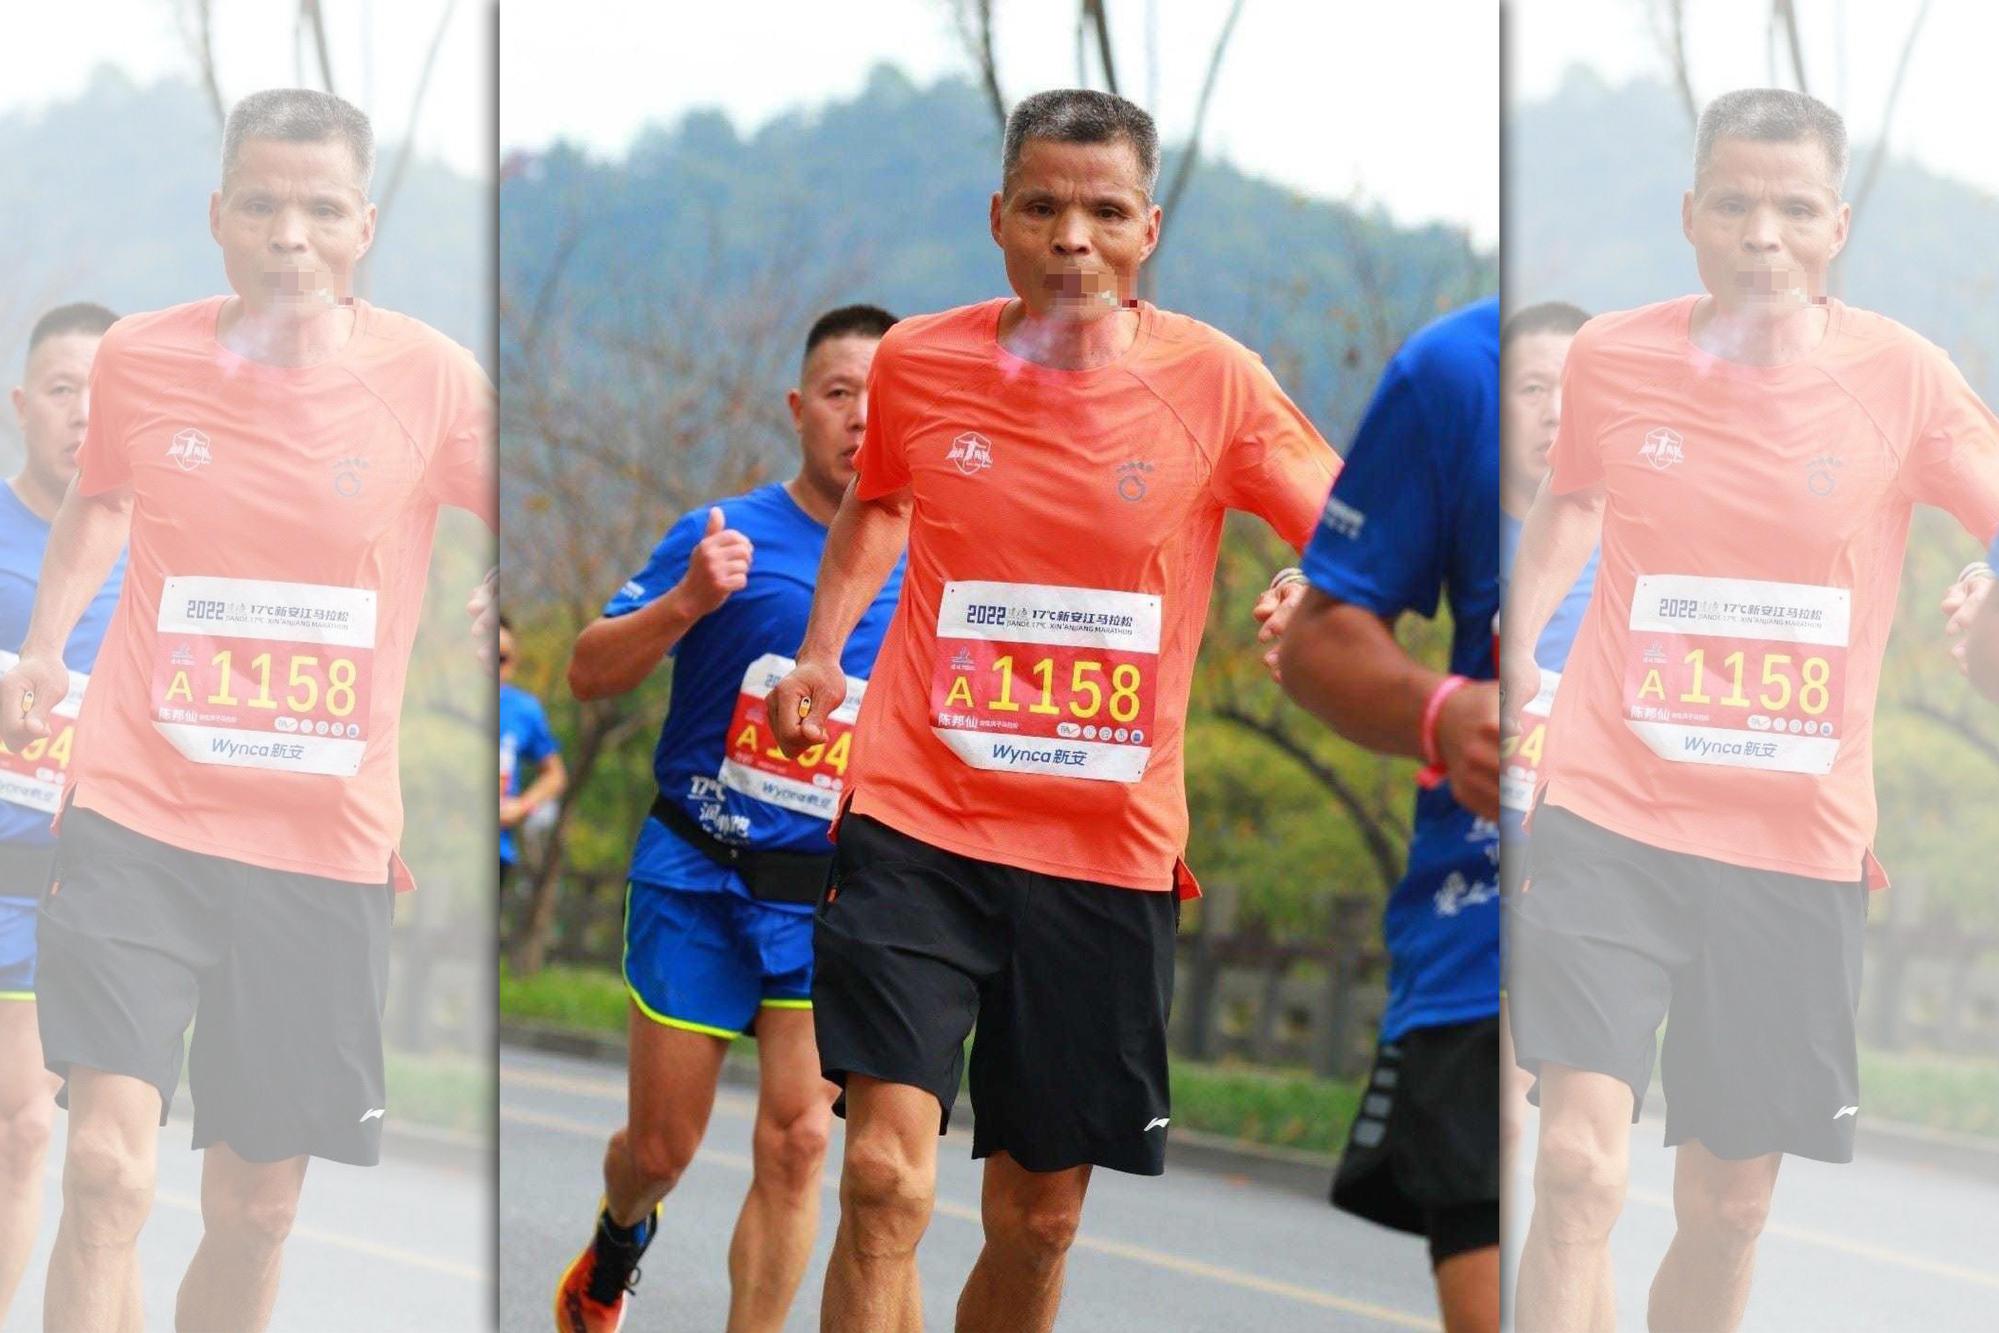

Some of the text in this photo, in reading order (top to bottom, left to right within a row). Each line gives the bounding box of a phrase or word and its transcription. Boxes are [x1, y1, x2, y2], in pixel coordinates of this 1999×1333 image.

[187, 600, 225, 620] 2022
[966, 603, 1007, 626] 2022
[1658, 598, 1698, 619] 2022
[164, 650, 357, 717] A 1158
[944, 655, 1141, 722] A 1158
[1637, 648, 1830, 716] A 1158
[735, 725, 759, 752] A
